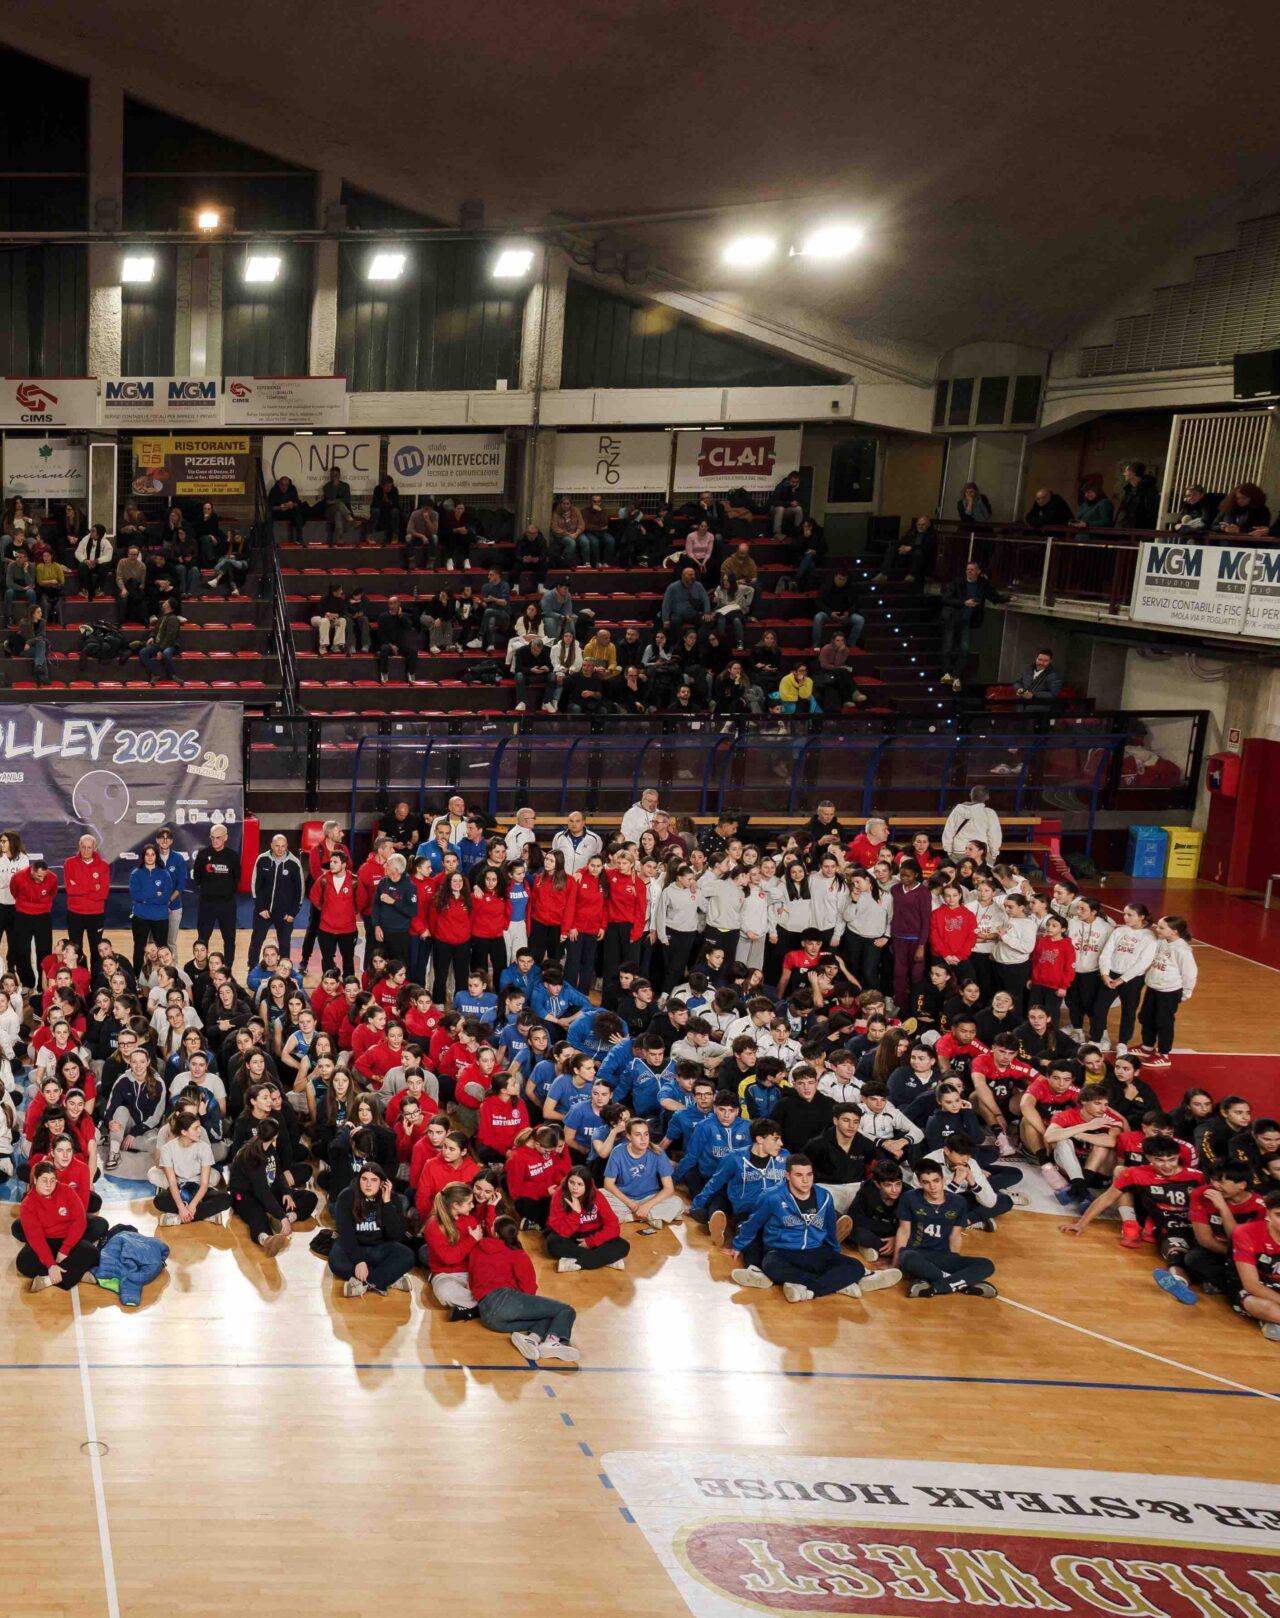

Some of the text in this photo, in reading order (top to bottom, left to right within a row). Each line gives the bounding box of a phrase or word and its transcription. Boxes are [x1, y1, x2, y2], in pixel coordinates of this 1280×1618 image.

[106, 382, 216, 399] MGM MGM
[21, 414, 53, 422] CIMS
[175, 441, 246, 451] RISTORANTE
[184, 457, 236, 466] PIZZERIA
[309, 443, 370, 472] NPC
[427, 453, 500, 466] MONTEVECCHI
[708, 446, 765, 467] CLAI
[1146, 546, 1280, 583] MGM MGM
[1153, 578, 1272, 595] STUDIO STUDIO
[1142, 596, 1280, 620] SERVIZI CONTABILI E FISCALI PER
[1171, 611, 1189, 620] IMOLA
[112, 729, 202, 764] 2026
[201, 751, 229, 772] 20
[1074, 943, 1099, 953] SIGNE
[1117, 944, 1134, 954] SIGNE
[461, 1005, 479, 1014] TEAM
[1166, 1190, 1186, 1205] 18
[923, 1223, 942, 1238] 41
[693, 1476, 910, 1506] HOUSE
[912, 1485, 1141, 1519] STEAK
[737, 1537, 1072, 1611] WEST
